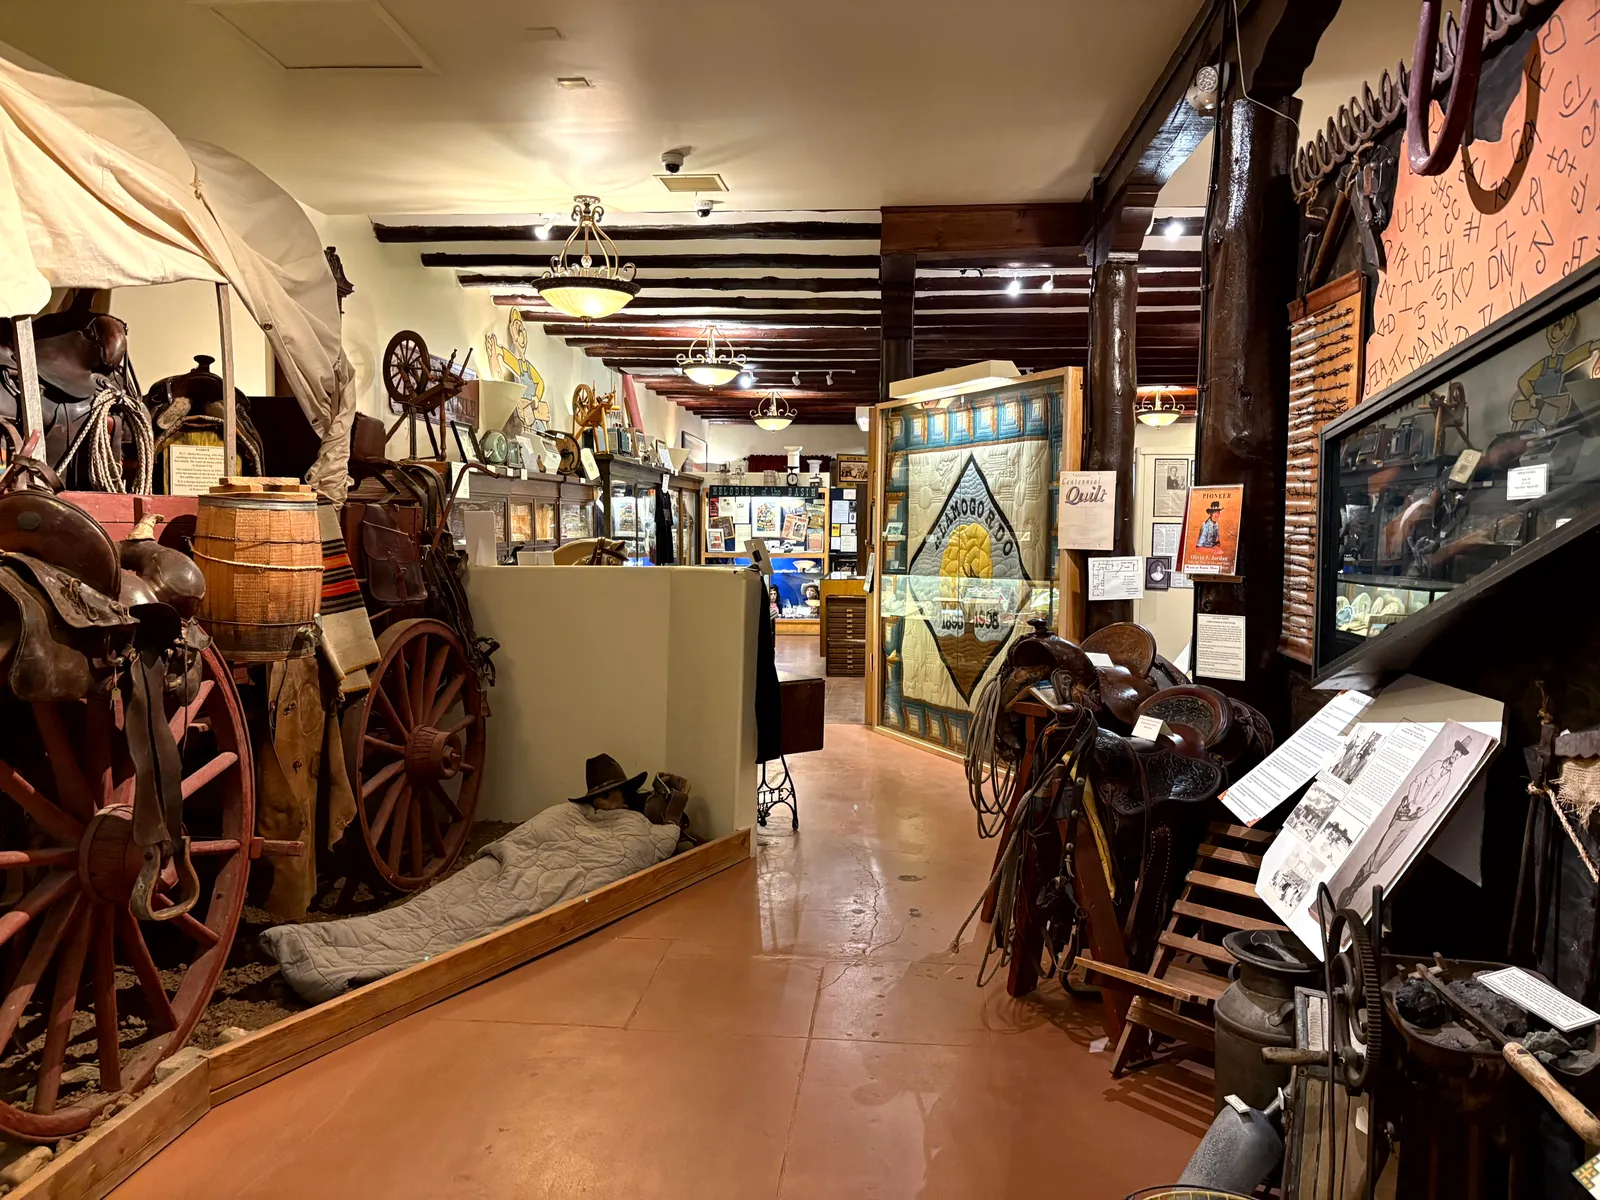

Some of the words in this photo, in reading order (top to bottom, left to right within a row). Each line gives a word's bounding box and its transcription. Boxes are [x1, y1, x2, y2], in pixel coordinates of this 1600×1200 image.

[1062, 477, 1102, 486] Centennial
[712, 487, 755, 496] MELODIES
[770, 488, 780, 496] the
[788, 488, 816, 496] BASIN
[1064, 485, 1108, 506] Quilt
[935, 498, 1014, 556] ALAMOGORDO
